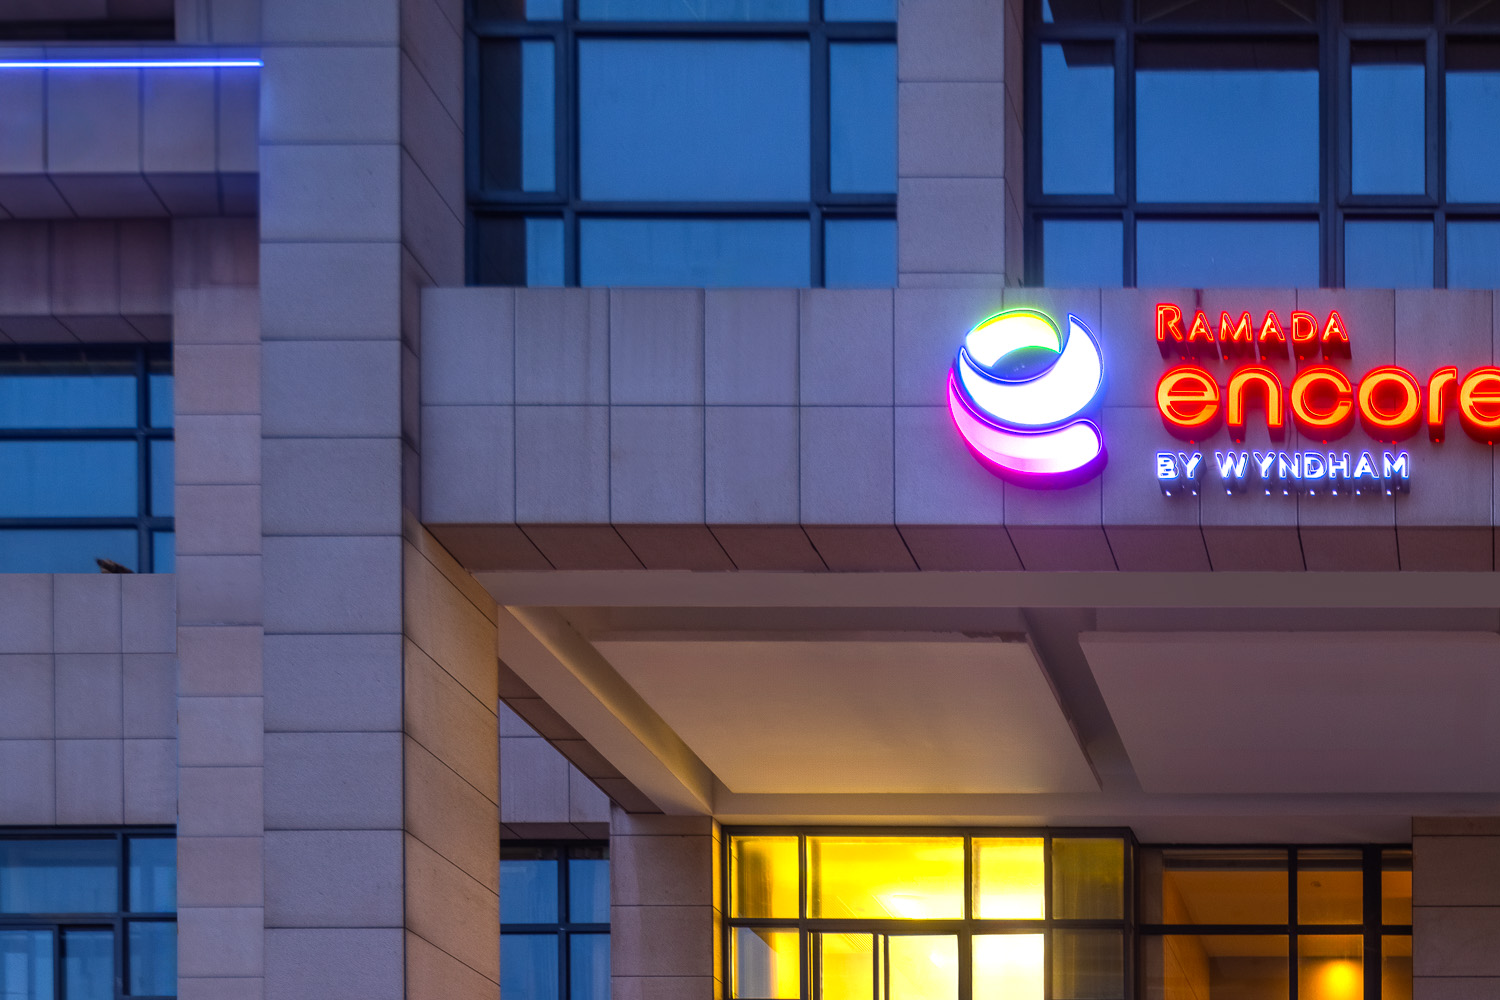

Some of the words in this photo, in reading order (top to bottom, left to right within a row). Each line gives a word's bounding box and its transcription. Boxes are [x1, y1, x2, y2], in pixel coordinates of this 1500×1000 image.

[1155, 303, 1350, 342] RAMADA
[1156, 451, 1203, 480] BY
[1214, 451, 1410, 480] WYNDHAM
